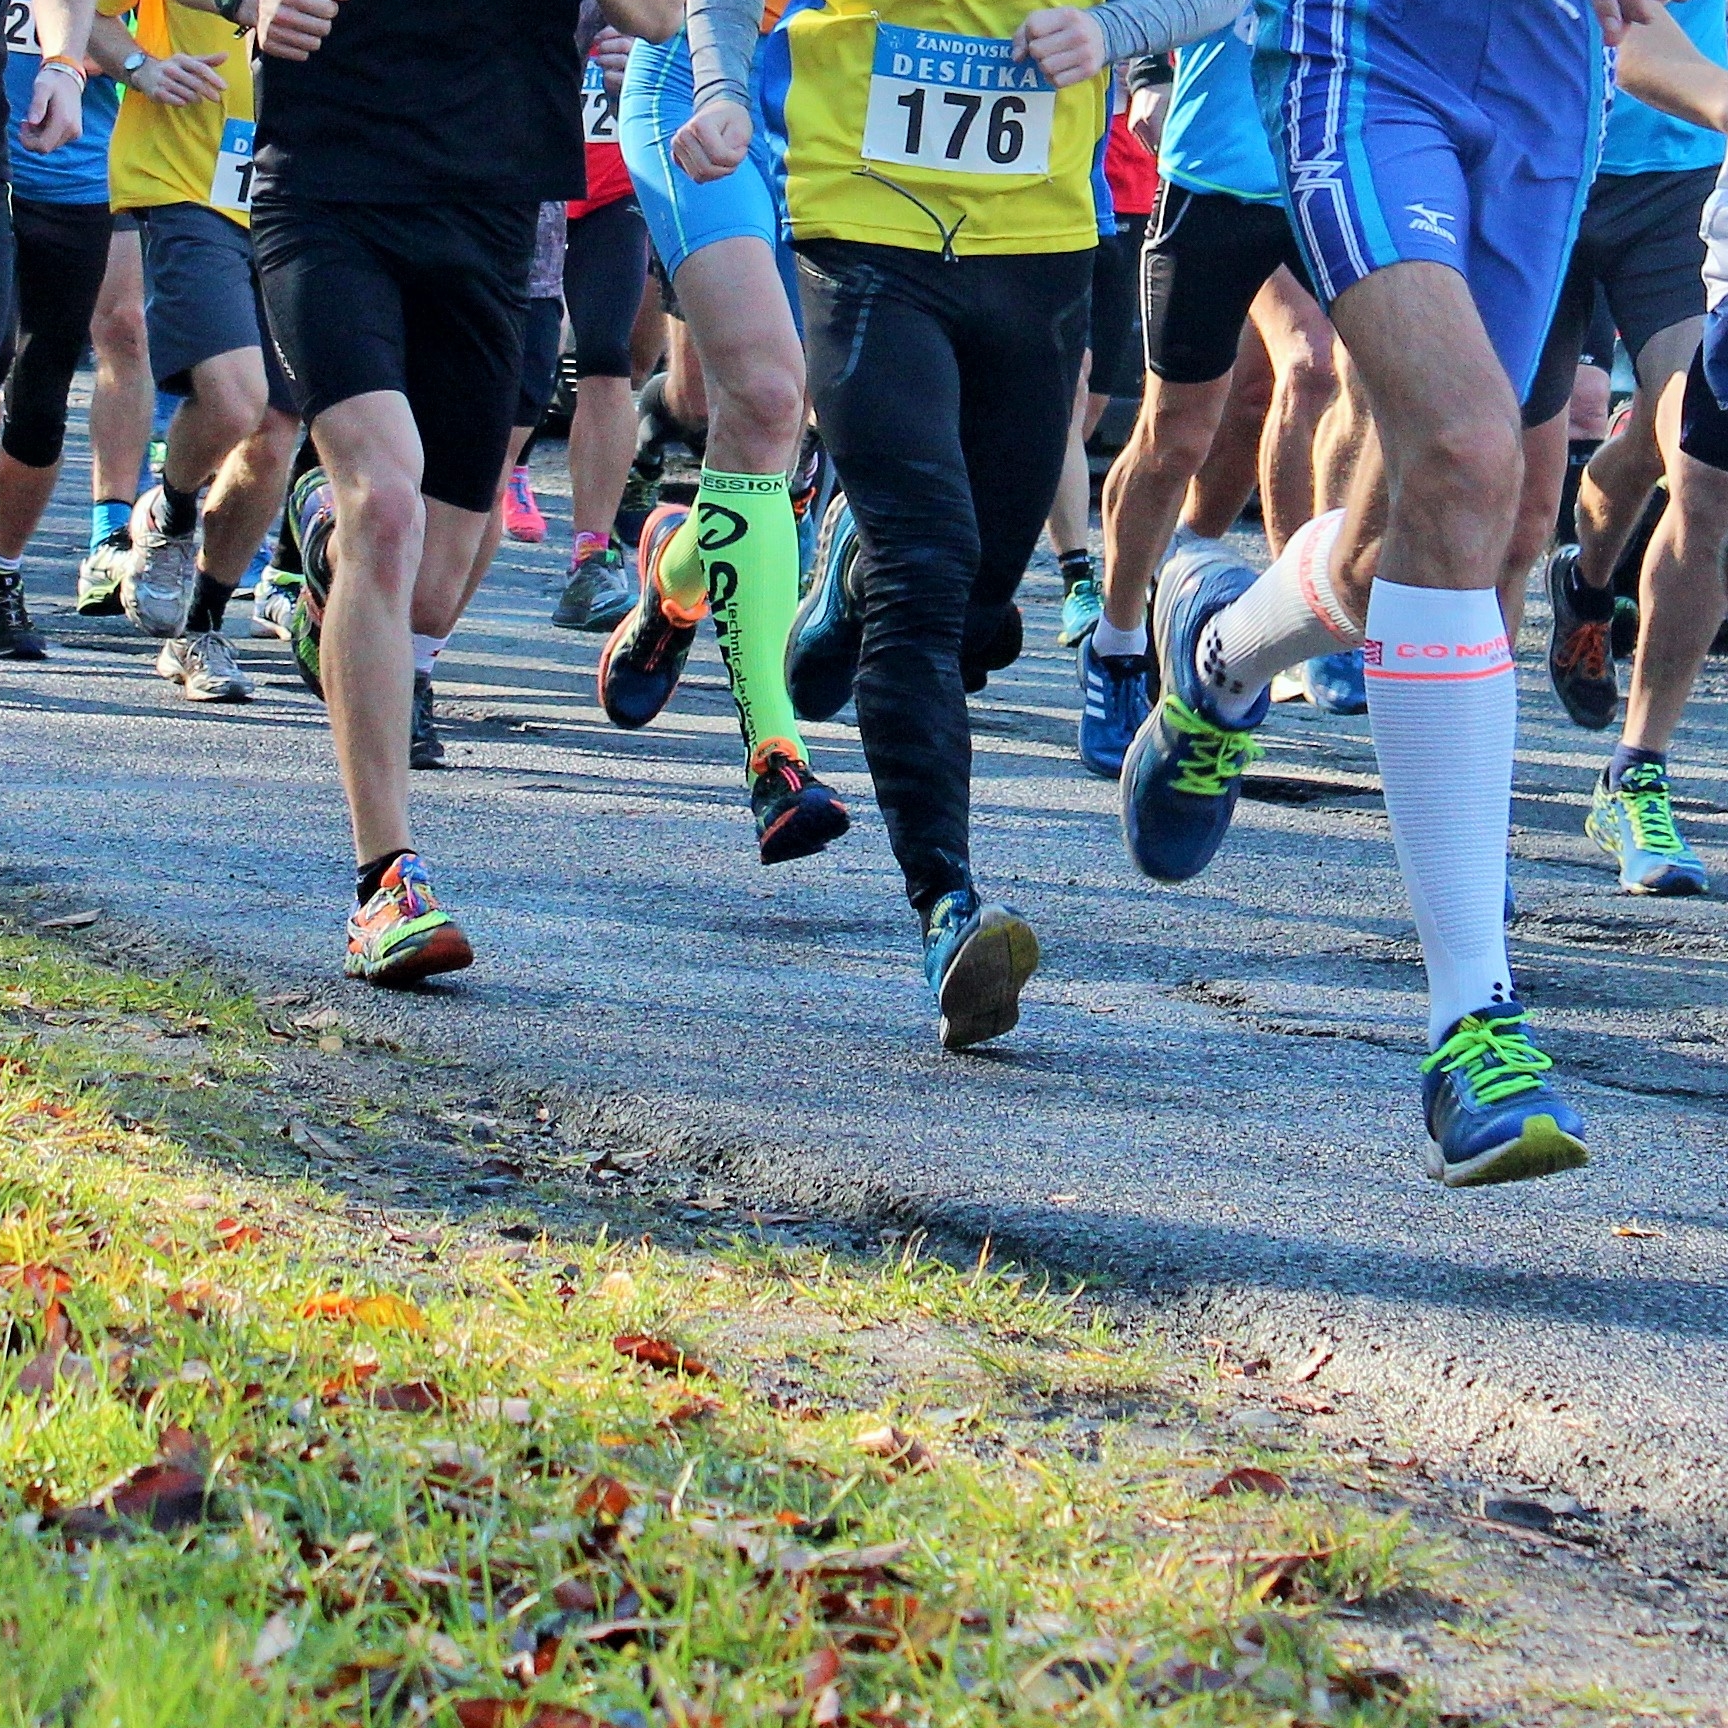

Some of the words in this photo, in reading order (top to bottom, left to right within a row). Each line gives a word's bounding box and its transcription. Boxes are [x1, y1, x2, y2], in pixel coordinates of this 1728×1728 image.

[916, 33, 1013, 60] ŽANDOVSK
[892, 53, 1039, 88] DESÍTKA
[897, 88, 1027, 165] 176
[701, 476, 784, 492] ESSION
